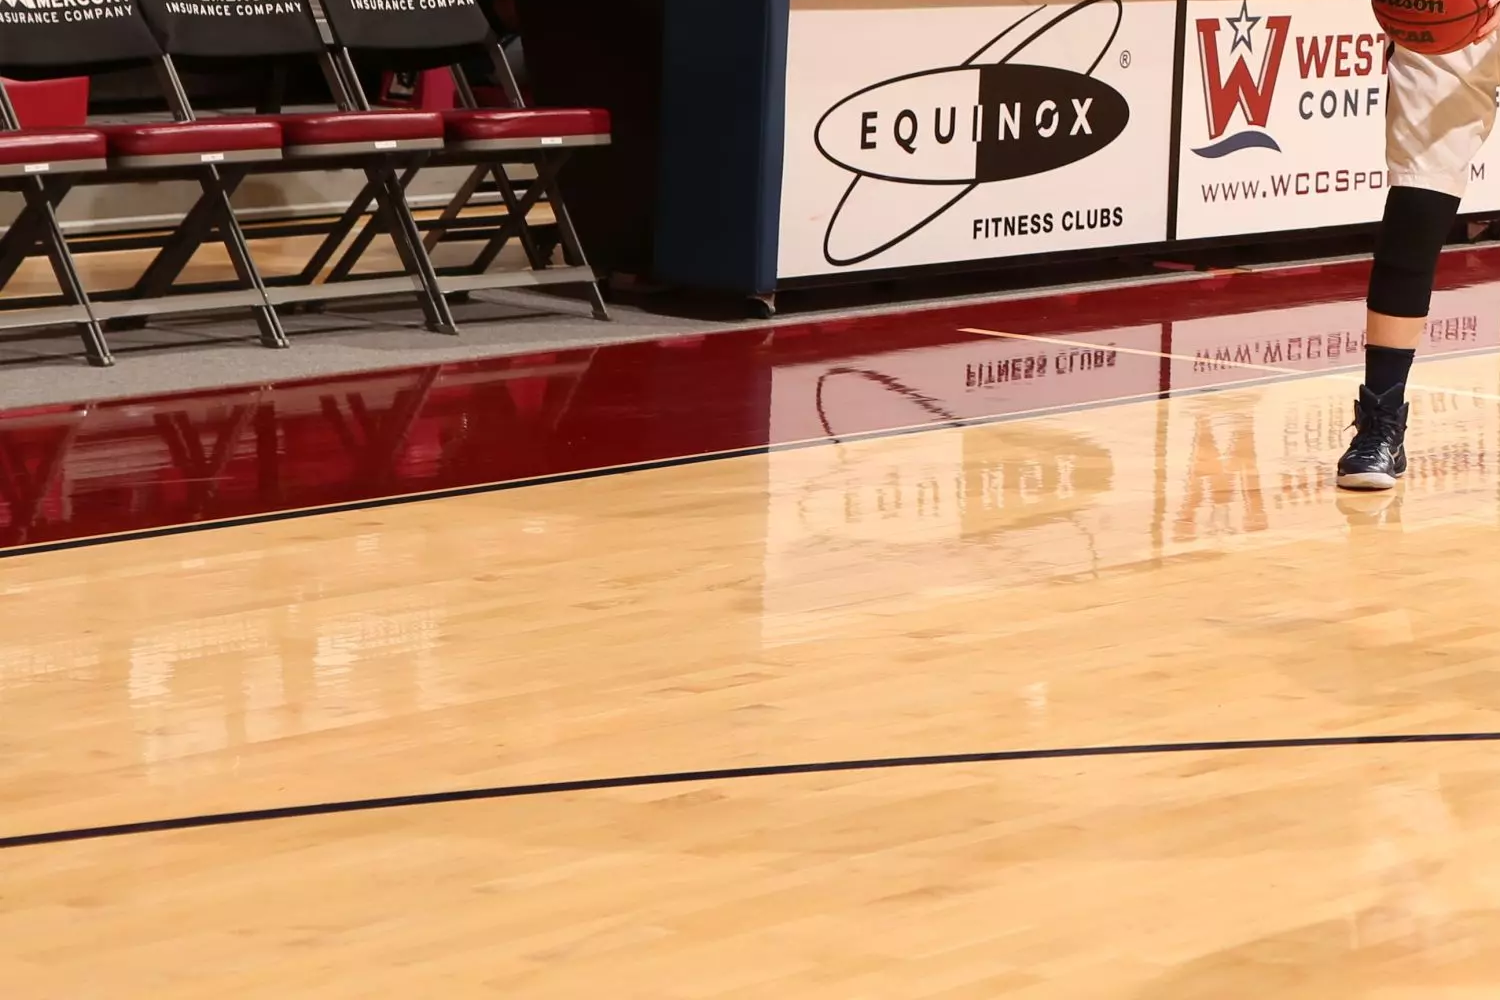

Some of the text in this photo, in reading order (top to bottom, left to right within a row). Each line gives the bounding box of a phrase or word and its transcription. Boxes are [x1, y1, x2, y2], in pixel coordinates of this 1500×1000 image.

[0, 4, 132, 24] SURANCE COMPANY
[166, 2, 302, 16] INSURANCE COMPANY
[350, 0, 415, 10] INSURANCE
[859, 97, 1094, 154] EQUINOX
[972, 206, 1124, 240] FITNESS CLUBS
